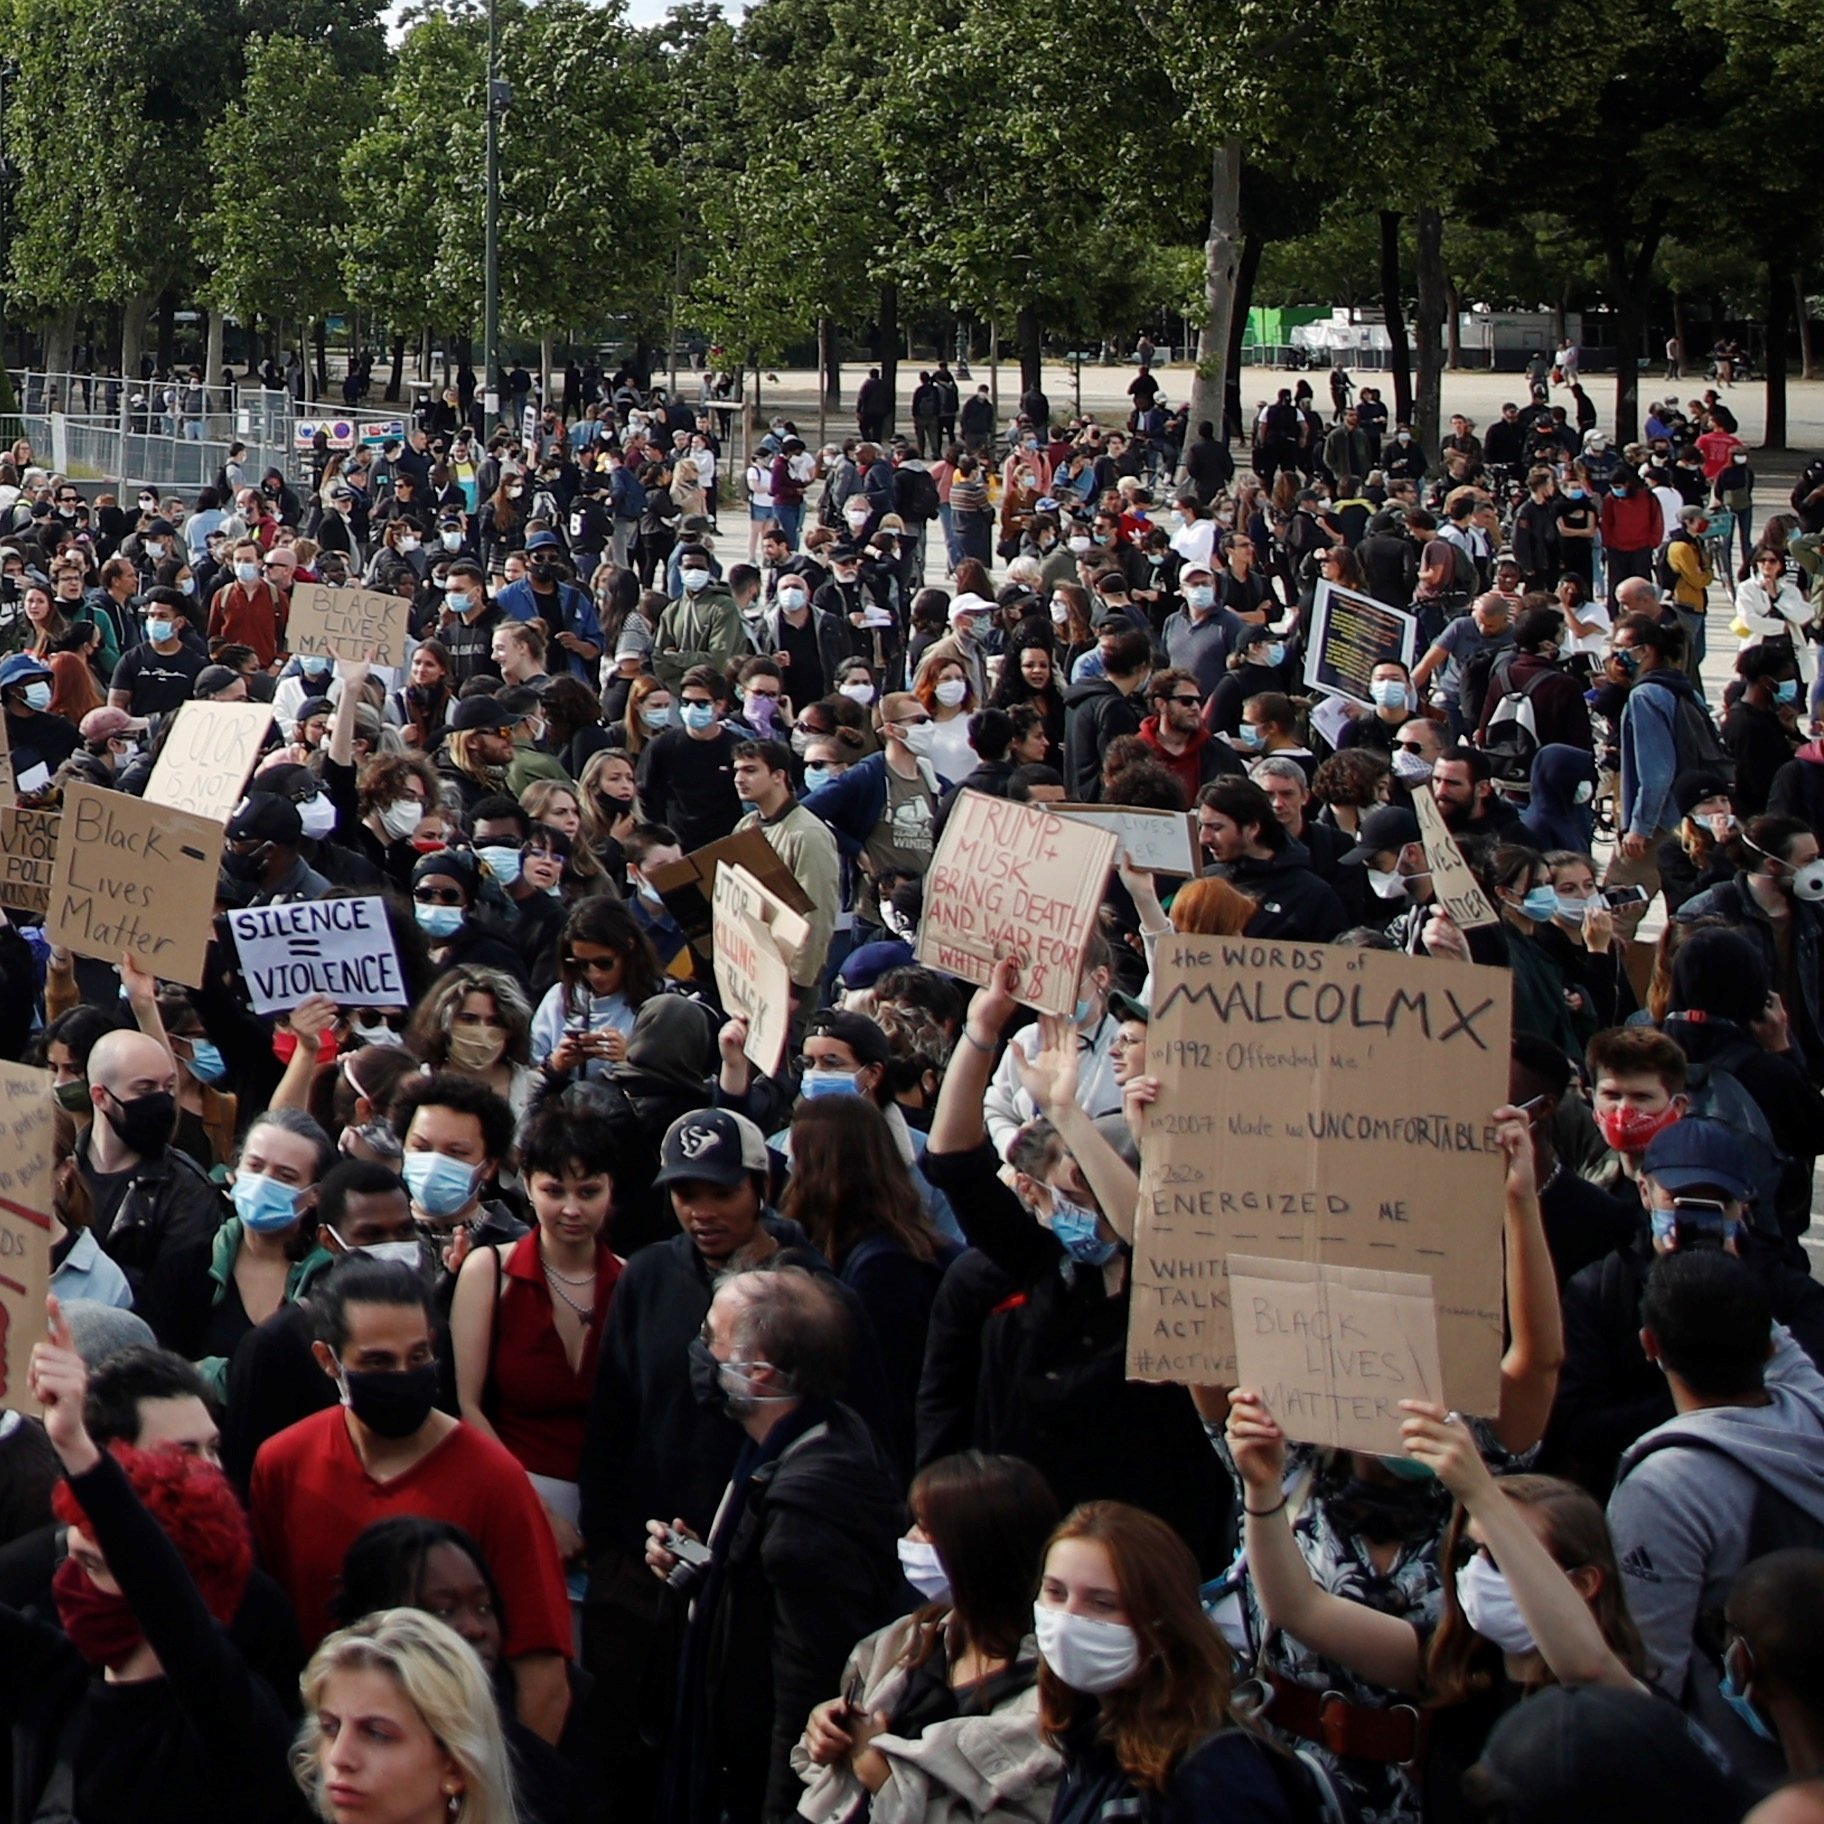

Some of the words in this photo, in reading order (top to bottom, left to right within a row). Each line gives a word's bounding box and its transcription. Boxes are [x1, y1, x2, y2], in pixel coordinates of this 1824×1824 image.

[312, 588, 400, 625] BLACK
[299, 634, 392, 665] MATTER
[323, 614, 390, 643] LIVES
[165, 708, 257, 769] COLOR
[166, 772, 183, 797] IS
[190, 771, 240, 798] NOT
[74, 798, 171, 863] Black
[963, 795, 1063, 862] TRUMP
[66, 847, 153, 908] Lives
[951, 837, 1032, 887] MUSK
[60, 895, 176, 955] Matter
[236, 900, 371, 941] SILENCE
[932, 866, 1003, 913] BRING
[1012, 888, 1087, 941] DEATH
[714, 919, 758, 983] KILLING
[928, 898, 975, 933] AND
[982, 914, 1032, 955] WAR
[1036, 937, 1079, 976] FOR
[1170, 946, 1213, 968] the
[1222, 944, 1323, 971] WORDS
[1346, 951, 1369, 972] of
[254, 952, 400, 1001] VIOLENCE
[726, 964, 769, 1036] BLACK
[1226, 1041, 1319, 1071] Offended
[1307, 1110, 1503, 1153] UNCOMFORTABLE
[1152, 1190, 1350, 1217] ENERGIZED
[1378, 1201, 1409, 1222] ME
[1156, 1285, 1229, 1309] TALK
[1251, 1295, 1368, 1341] BLACK
[1153, 1320, 1206, 1338] ACT
[1304, 1348, 1406, 1383] LIVES
[1261, 1381, 1399, 1422] MATTER
